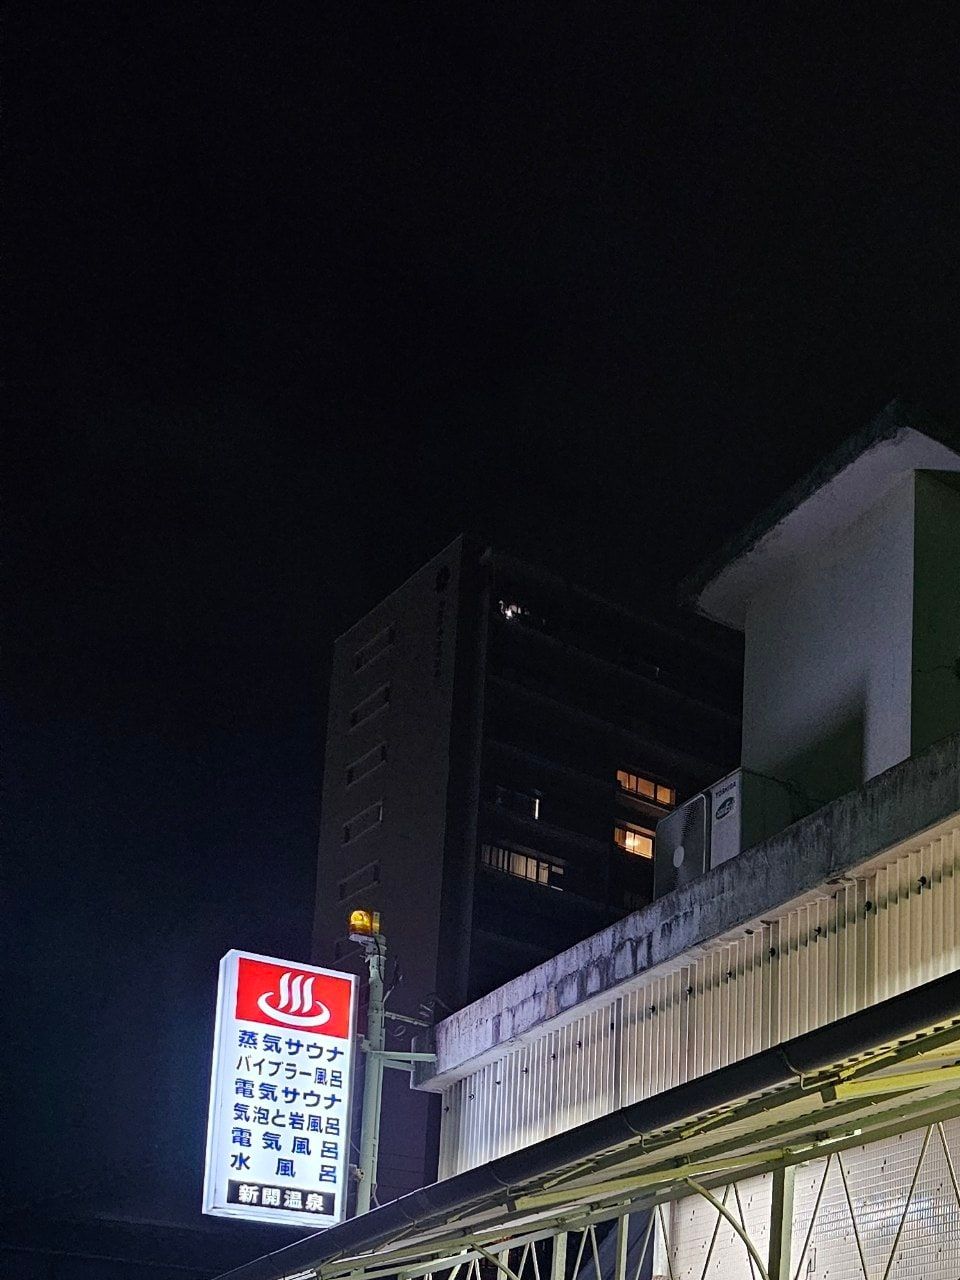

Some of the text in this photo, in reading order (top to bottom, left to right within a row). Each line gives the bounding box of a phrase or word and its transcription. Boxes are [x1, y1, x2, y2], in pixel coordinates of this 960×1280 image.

[238, 1028, 345, 1063] 蒸気サウナ
[236, 1054, 343, 1089] バイブラー風呂
[234, 1077, 342, 1110] 電気サウナ
[233, 1102, 340, 1136] 気泡と岩風呂
[231, 1126, 339, 1160] 電気風呂
[229, 1152, 338, 1184] 水風呂
[237, 1183, 325, 1212] 新開温泉
